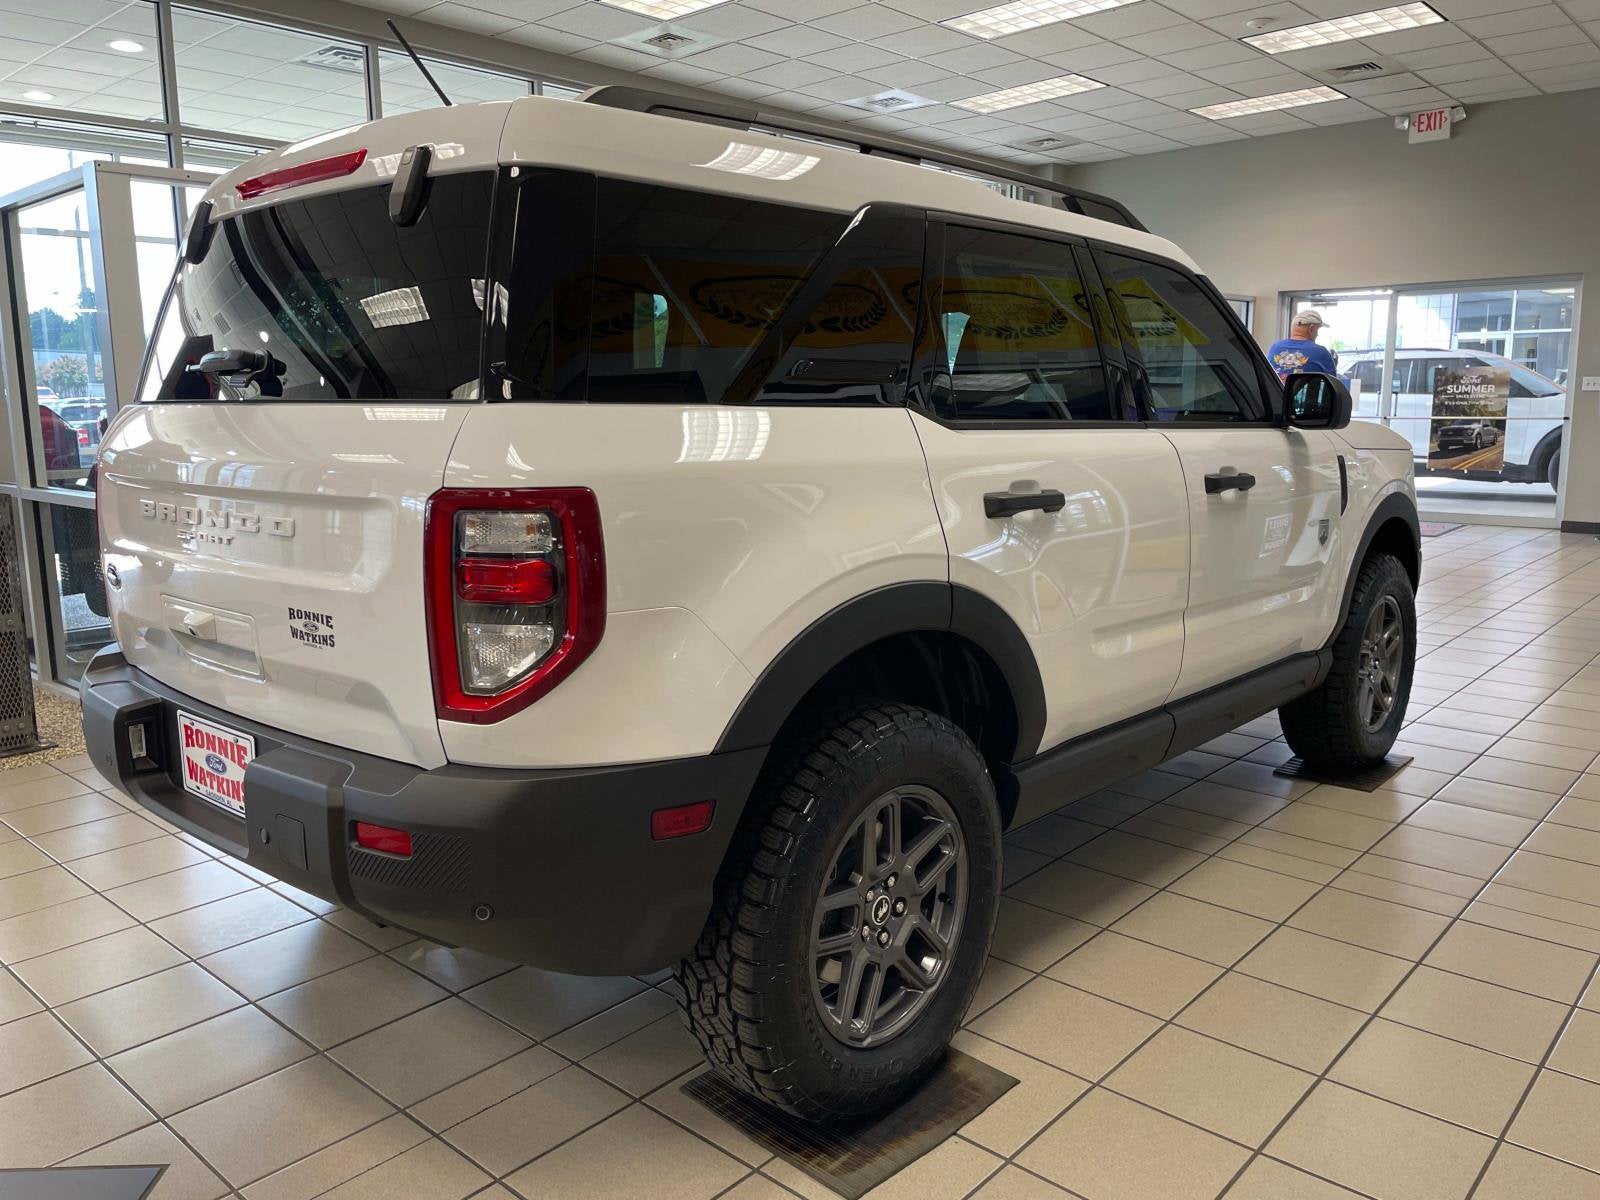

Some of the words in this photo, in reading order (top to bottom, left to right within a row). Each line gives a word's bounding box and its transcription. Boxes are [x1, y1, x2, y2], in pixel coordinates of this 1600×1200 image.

[1417, 110, 1445, 133] EXIT
[1447, 385, 1495, 393] SUMMER
[140, 499, 295, 538] BRONCO
[288, 607, 334, 630] RONNIE
[290, 625, 335, 648] WATKINS
[184, 724, 247, 769] RONNIE
[209, 757, 224, 772] Ford
